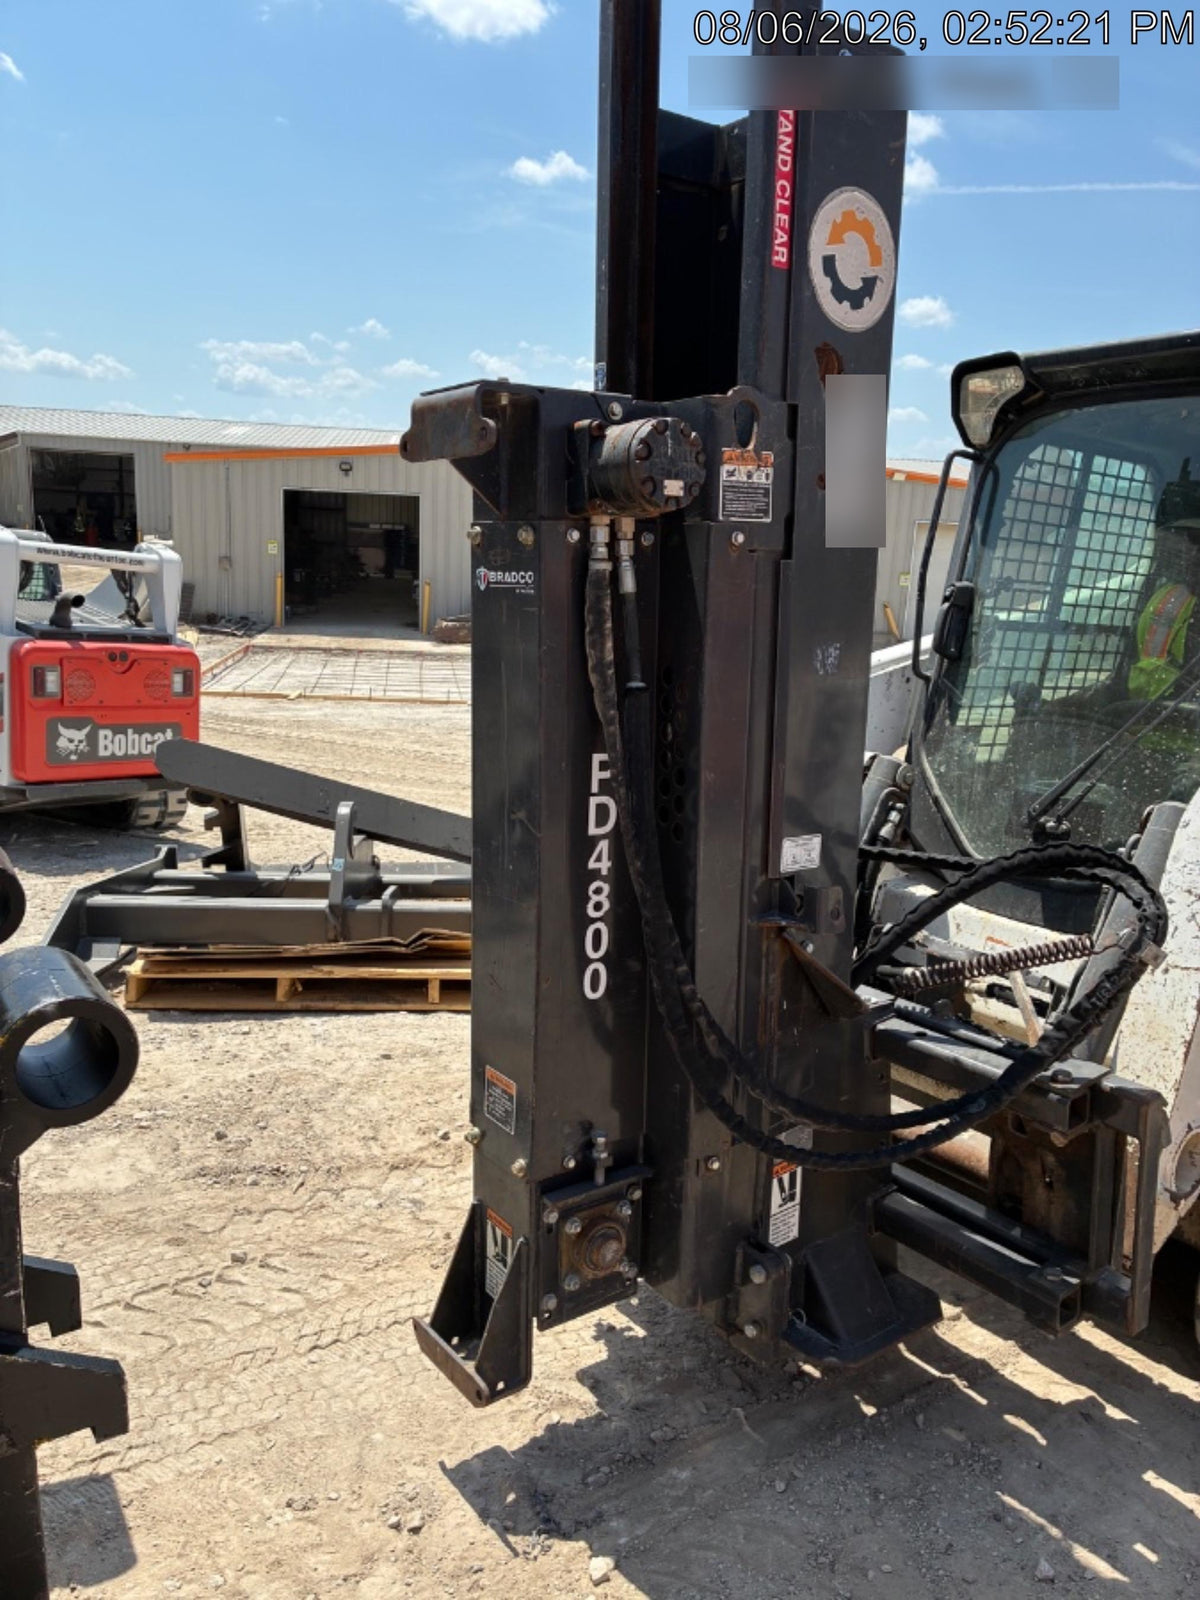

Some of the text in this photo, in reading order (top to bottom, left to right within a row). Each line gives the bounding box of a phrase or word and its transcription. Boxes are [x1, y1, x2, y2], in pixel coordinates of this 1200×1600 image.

[773, 110, 794, 264] TAND CLEAR
[488, 571, 535, 584] BRADCO
